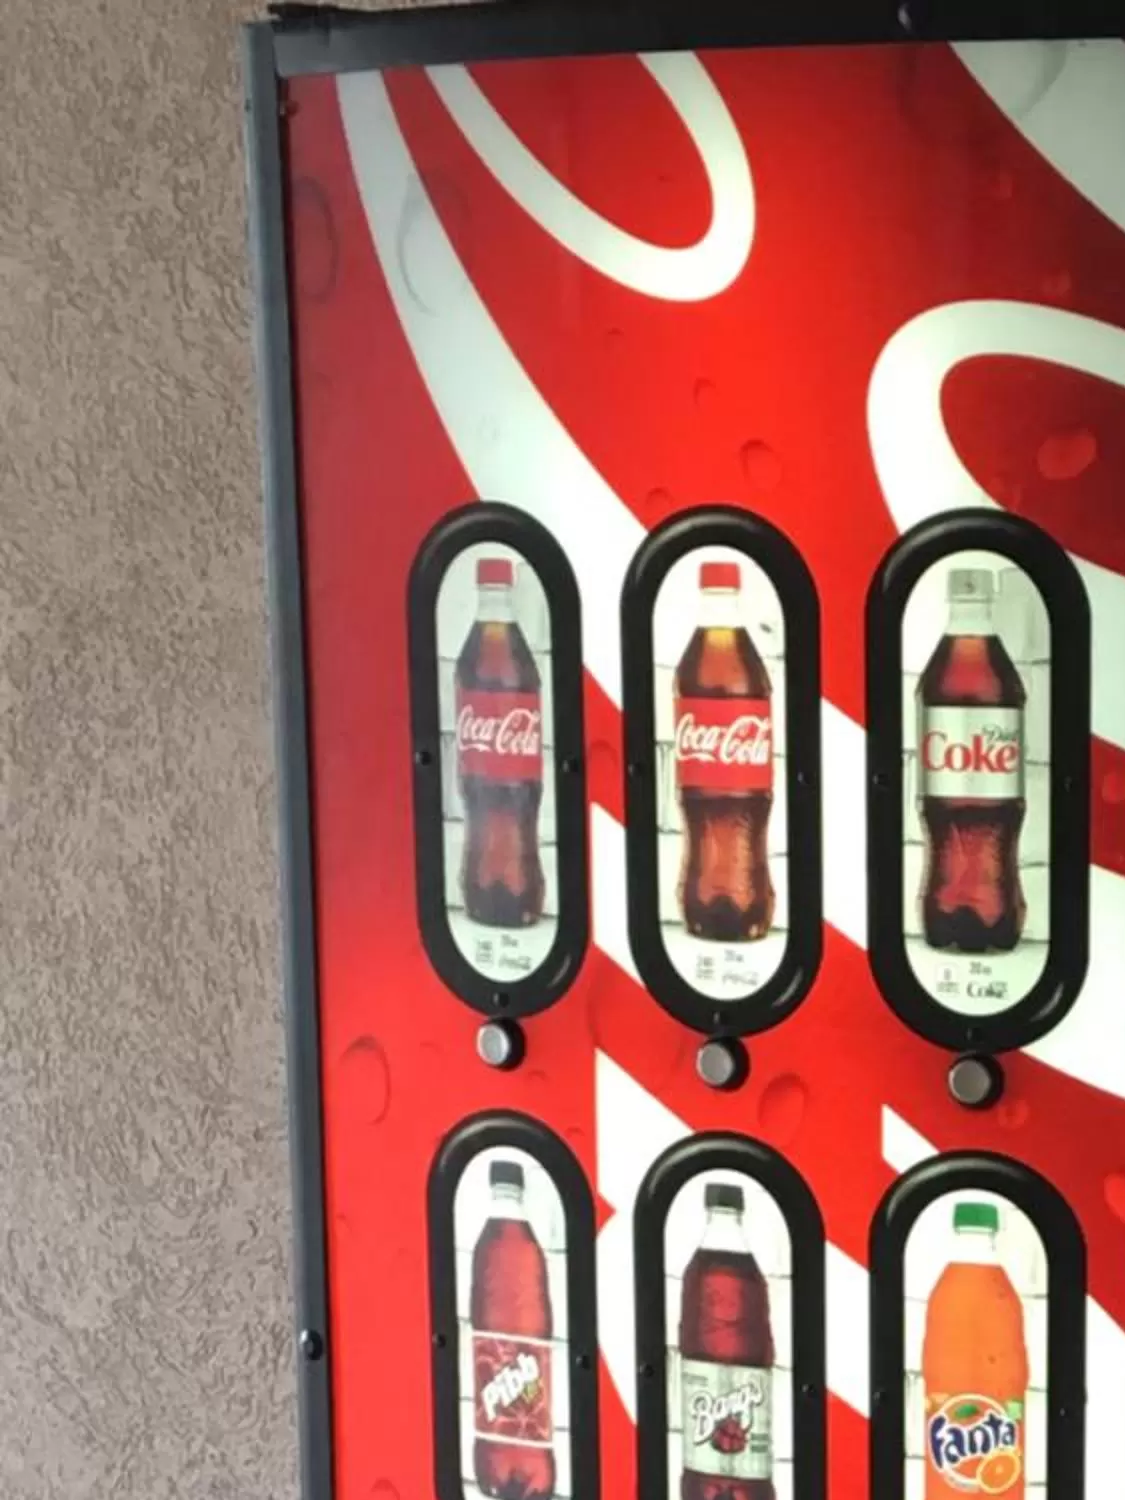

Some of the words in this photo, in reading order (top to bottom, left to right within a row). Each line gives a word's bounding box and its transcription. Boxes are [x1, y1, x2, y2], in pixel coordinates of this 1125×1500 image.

[456, 705, 540, 756] Coca-Cola
[675, 713, 771, 765] Coca-Cola
[922, 730, 1019, 774] Coke
